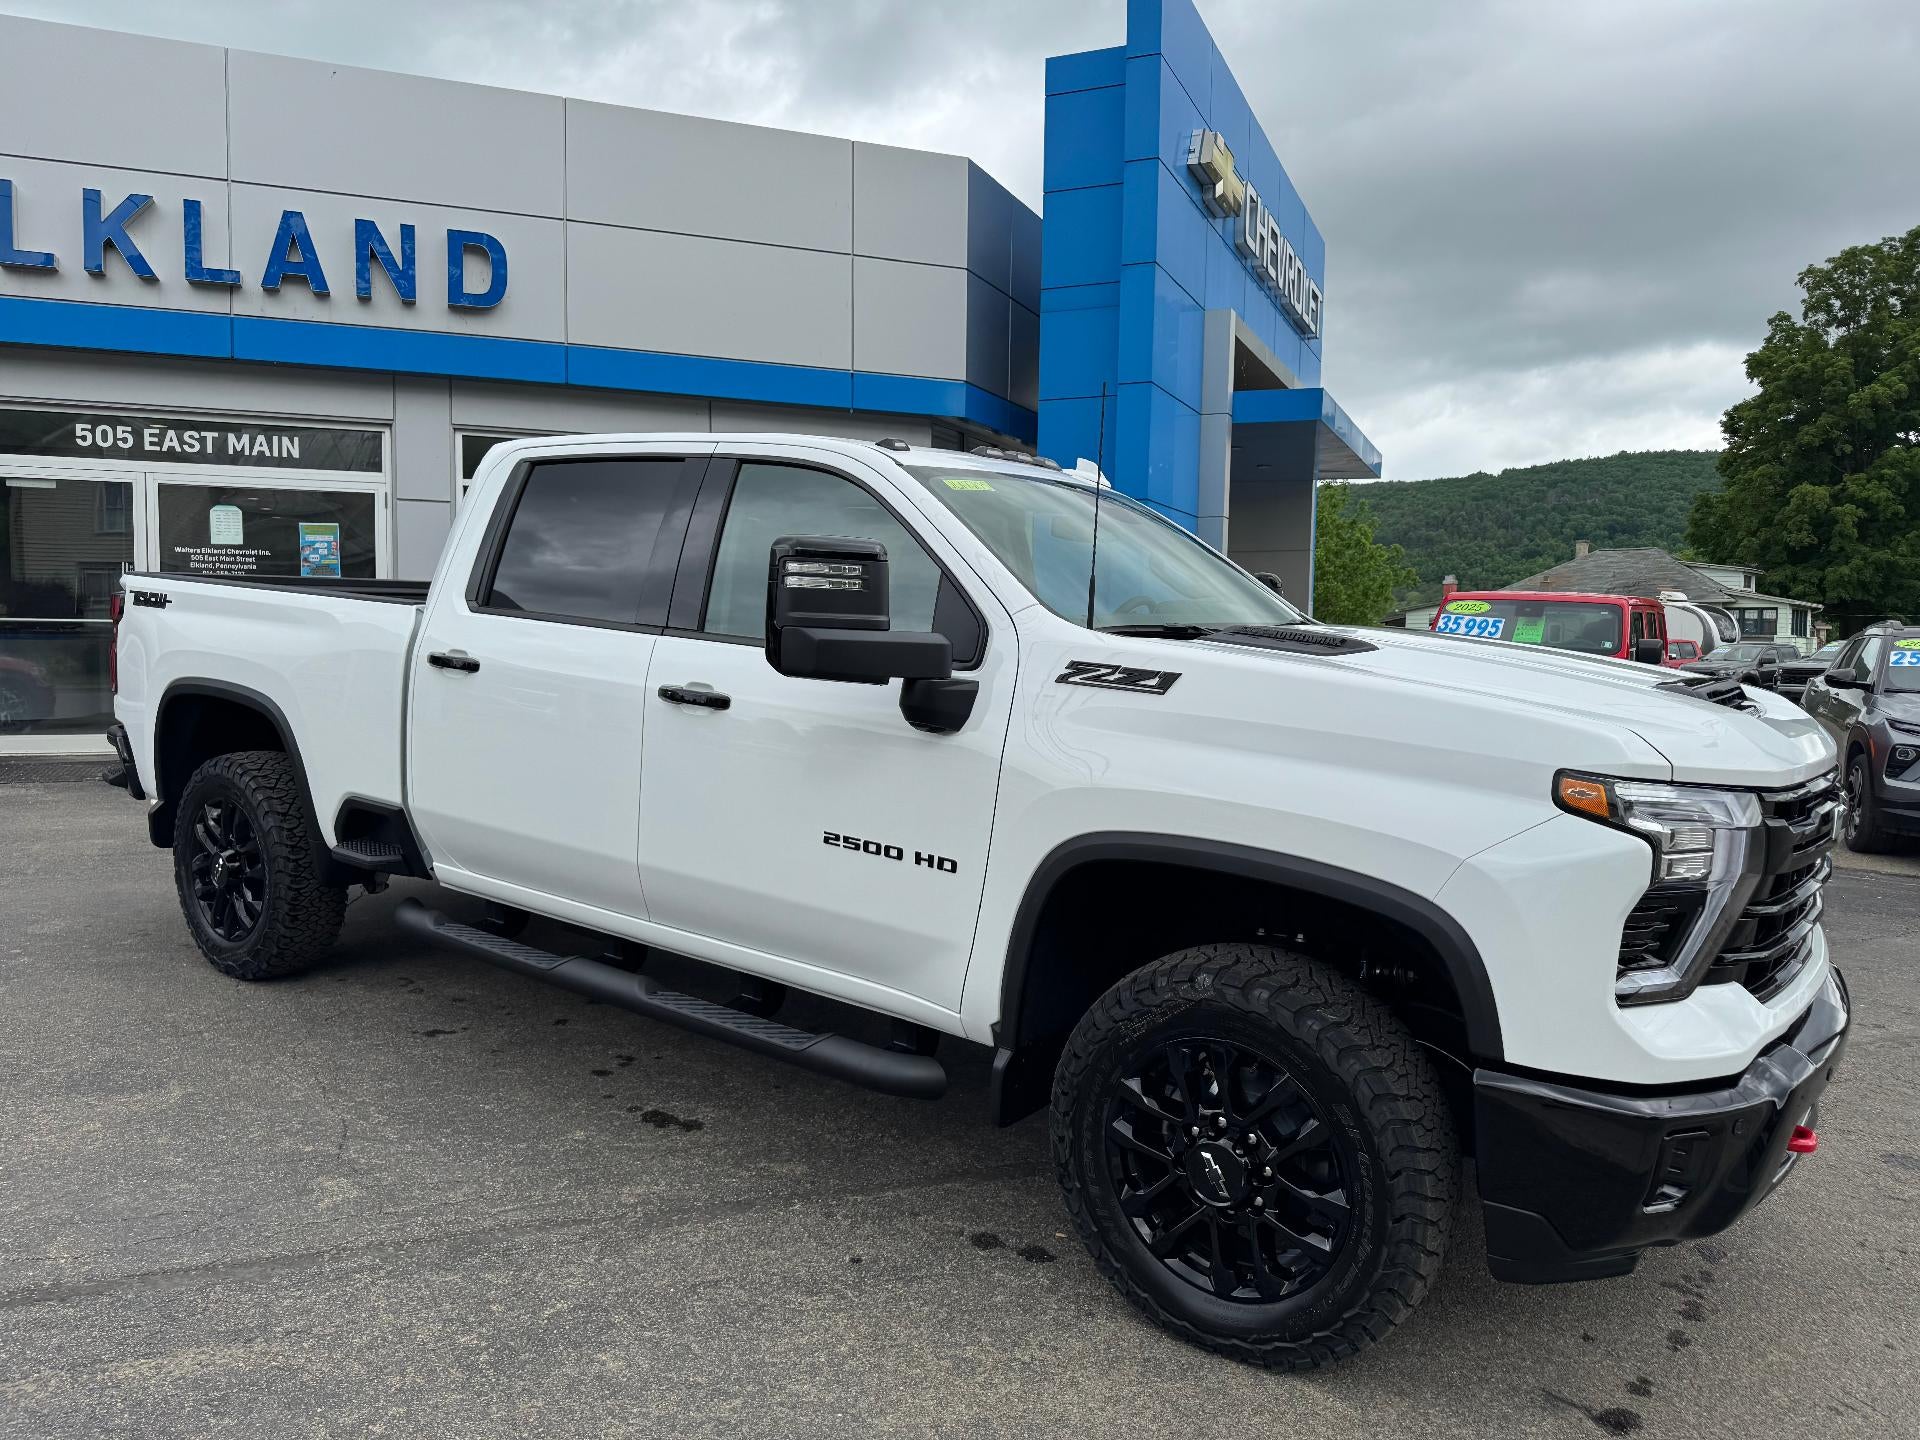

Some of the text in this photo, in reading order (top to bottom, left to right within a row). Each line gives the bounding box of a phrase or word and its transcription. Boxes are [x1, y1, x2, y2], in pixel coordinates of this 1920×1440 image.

[0, 178, 508, 310] LKLAND
[1238, 181, 1323, 338] CHEVROLET
[75, 423, 300, 458] 505 EAST MAIN
[190, 561, 257, 570] Elkland, Pennsylvania
[201, 547, 226, 555] Elkland
[227, 548, 258, 556] Chevrolet
[236, 555, 256, 563] Street
[1453, 603, 1485, 612] 2025
[1054, 660, 1183, 695] Z71
[823, 830, 958, 874] 2500 HD
